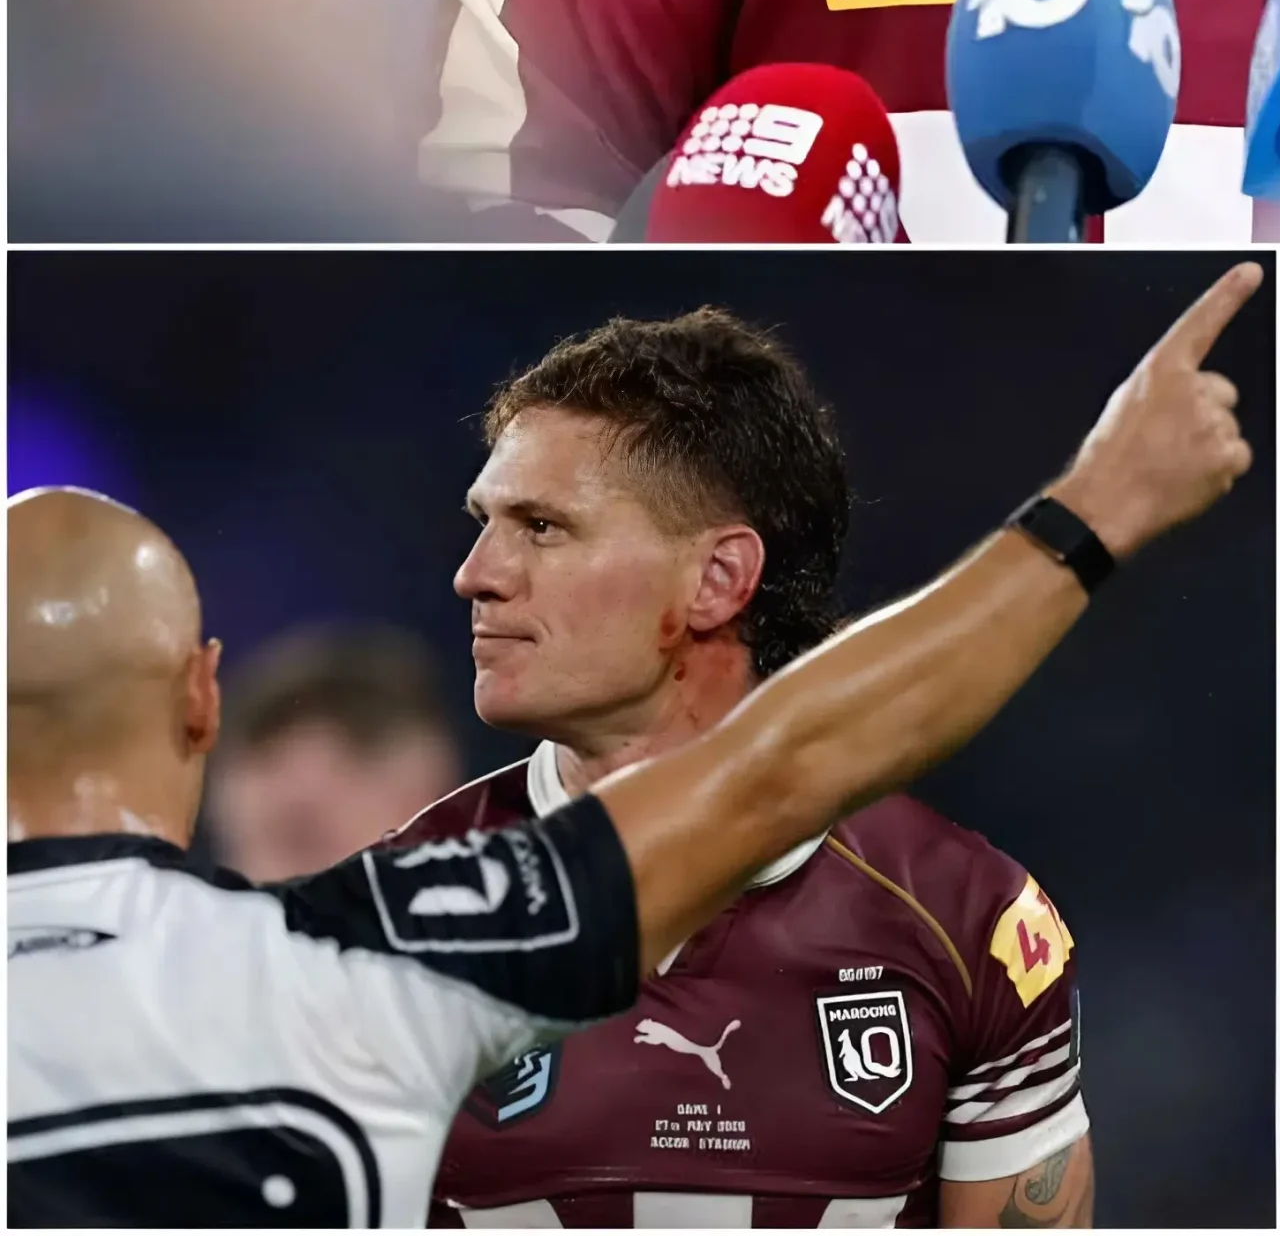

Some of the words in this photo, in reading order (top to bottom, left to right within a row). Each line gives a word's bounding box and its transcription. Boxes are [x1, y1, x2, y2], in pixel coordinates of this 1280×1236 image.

[743, 103, 824, 165] 9
[666, 153, 798, 197] NEWS
[829, 1005, 897, 1022] MAROONS
